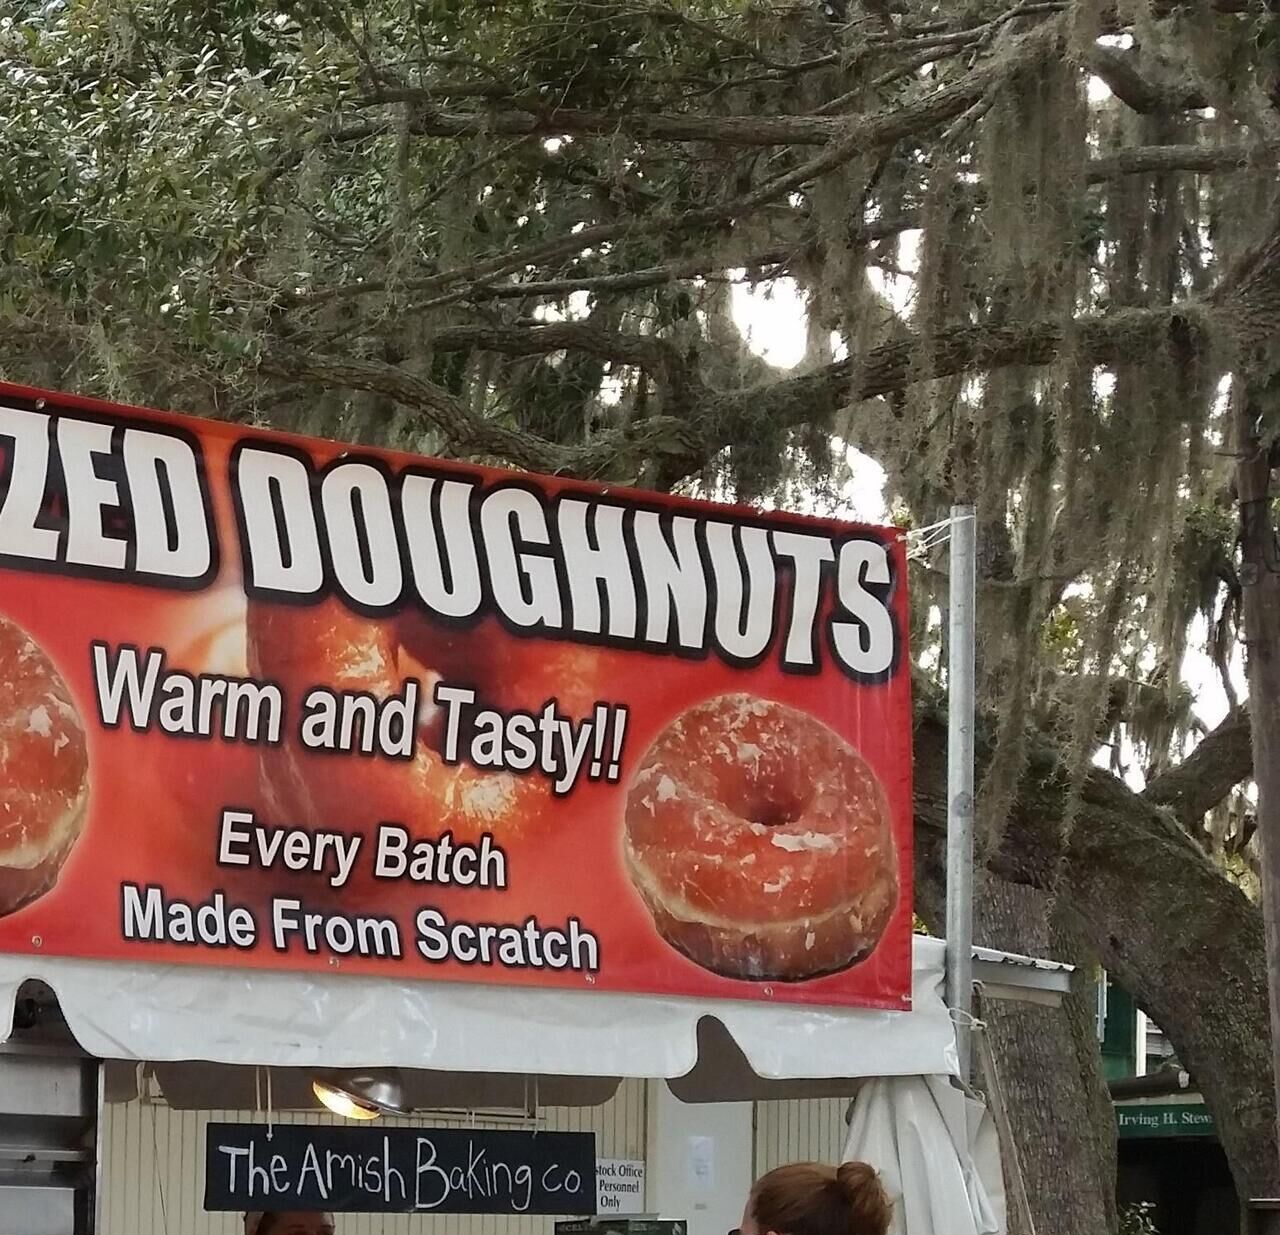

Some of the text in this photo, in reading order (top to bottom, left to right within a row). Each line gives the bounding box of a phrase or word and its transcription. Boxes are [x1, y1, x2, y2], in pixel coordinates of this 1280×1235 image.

[236, 444, 900, 680] DOUGHNUTS
[93, 645, 628, 794] Warm and Tasty!!
[217, 811, 507, 890] Every Batch
[122, 888, 600, 971] Made From Scratch
[1119, 1112, 1159, 1128] Irving
[1163, 1112, 1178, 1125] H.
[218, 1140, 291, 1197] The
[296, 1135, 407, 1202] Amish
[600, 1179, 640, 1193] Personnel
[618, 1164, 643, 1178] Office
[600, 1195, 621, 1212] Only
